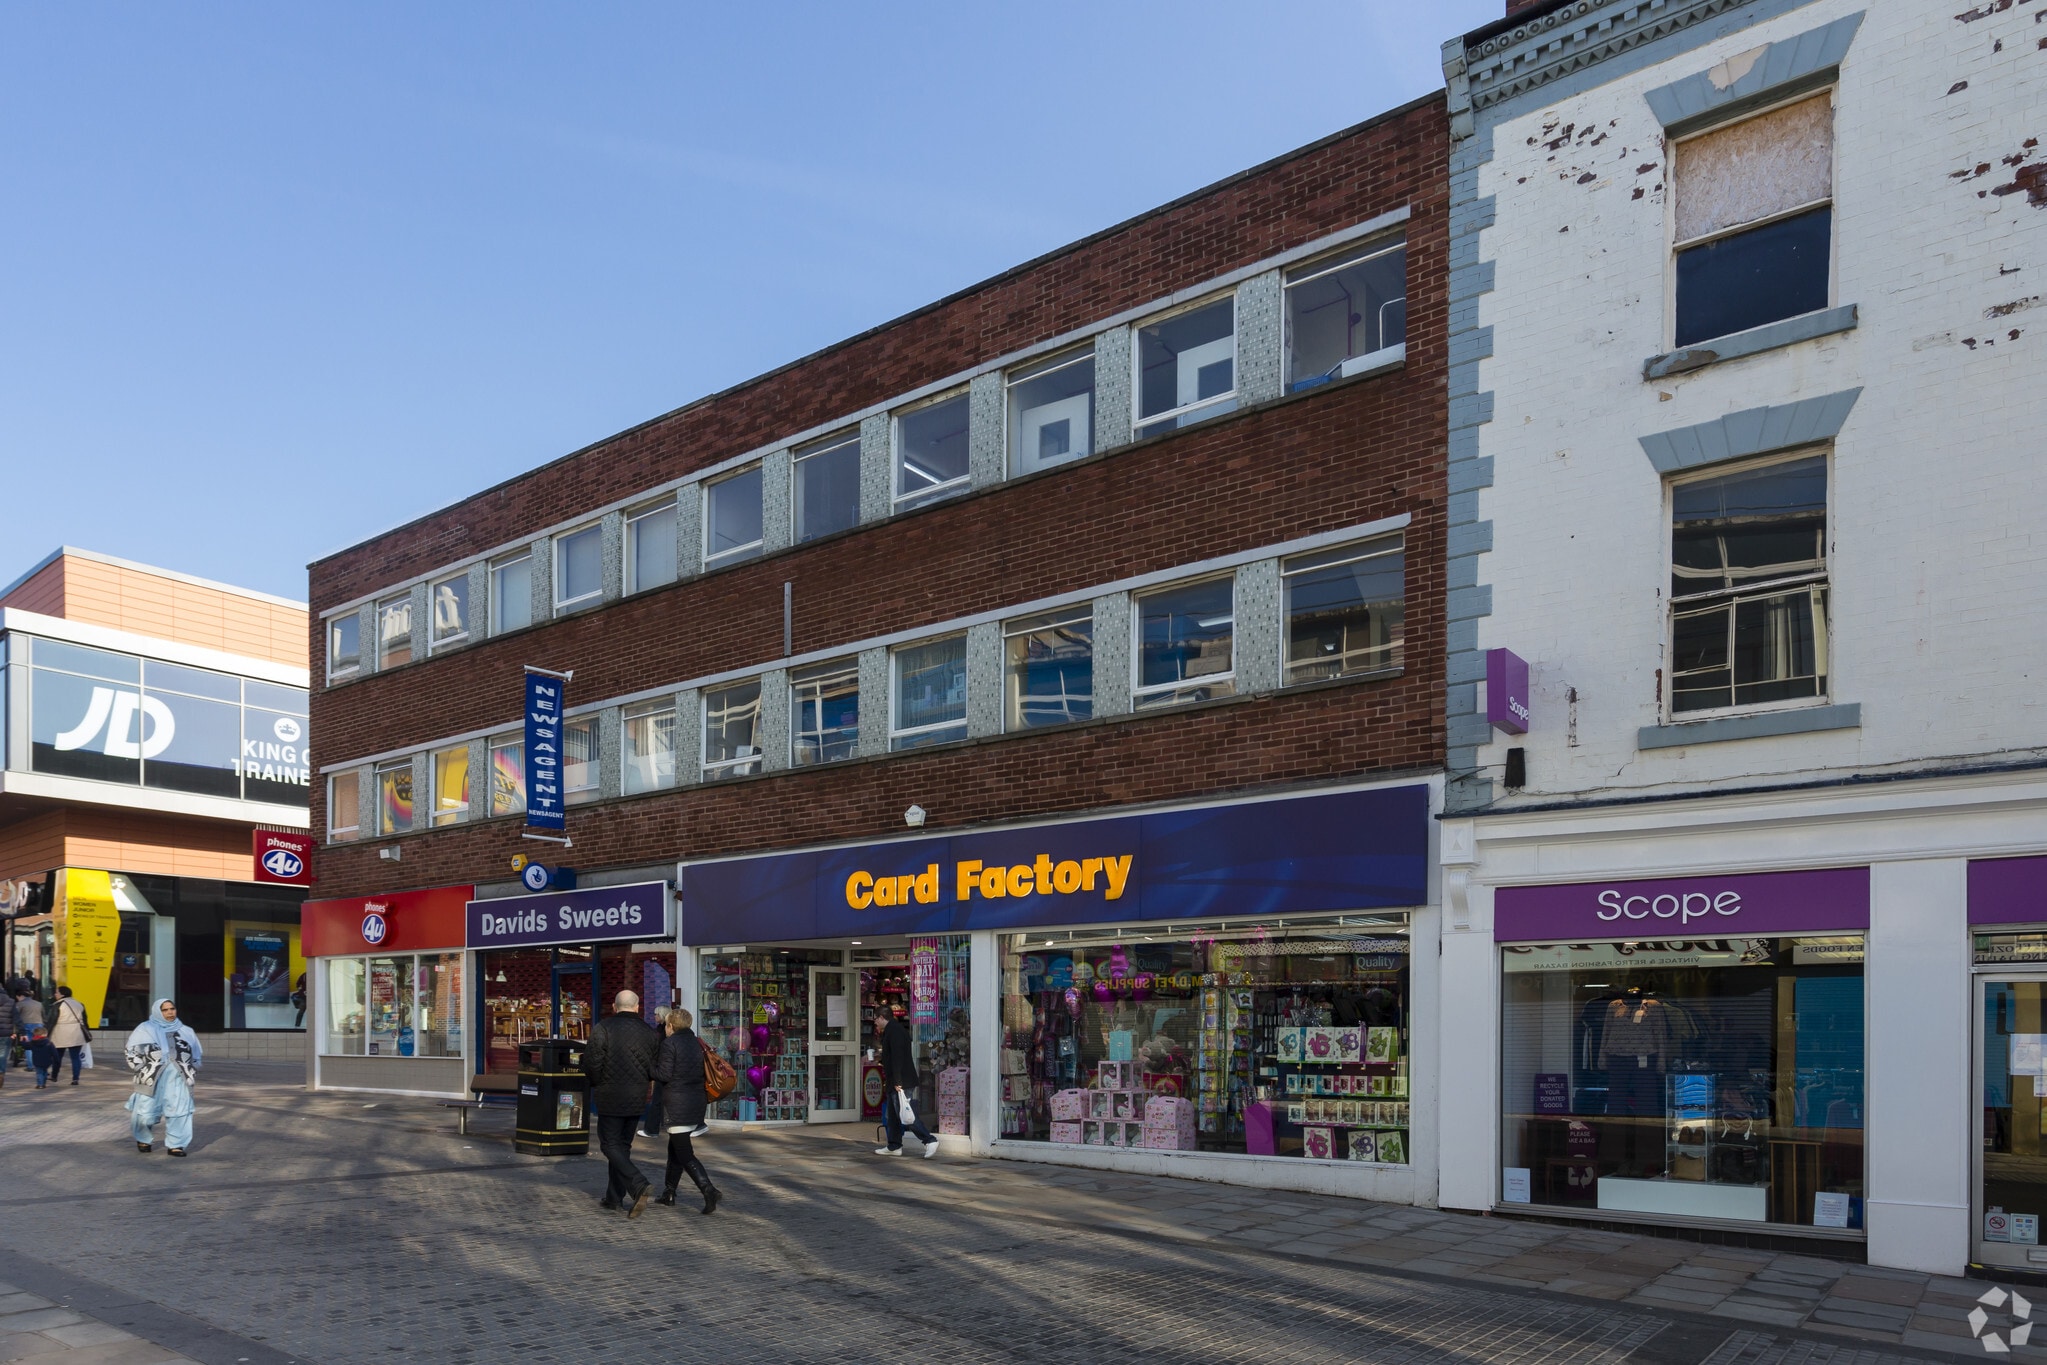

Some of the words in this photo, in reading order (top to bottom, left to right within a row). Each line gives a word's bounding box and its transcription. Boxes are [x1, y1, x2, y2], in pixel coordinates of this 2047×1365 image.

[1509, 696, 1529, 721] Scope
[55, 686, 176, 759] JD
[243, 739, 298, 762] KING
[531, 685, 559, 807] NEWSAGENT
[529, 809, 564, 818] NEWSAGENT
[267, 837, 303, 852] phones
[266, 852, 300, 875] 4u
[845, 863, 940, 910] Card
[956, 853, 1134, 901] Factory
[364, 902, 386, 913] phones
[1596, 889, 1742, 924] Scope
[364, 916, 385, 941] 4u
[481, 910, 548, 937] Davids
[558, 900, 642, 931] Sweets
[916, 964, 933, 977] DAY
[1138, 958, 1167, 972] Quality
[1356, 956, 1395, 970] Quality
[914, 987, 937, 998] CARDS
[916, 1002, 935, 1011] GIFTS
